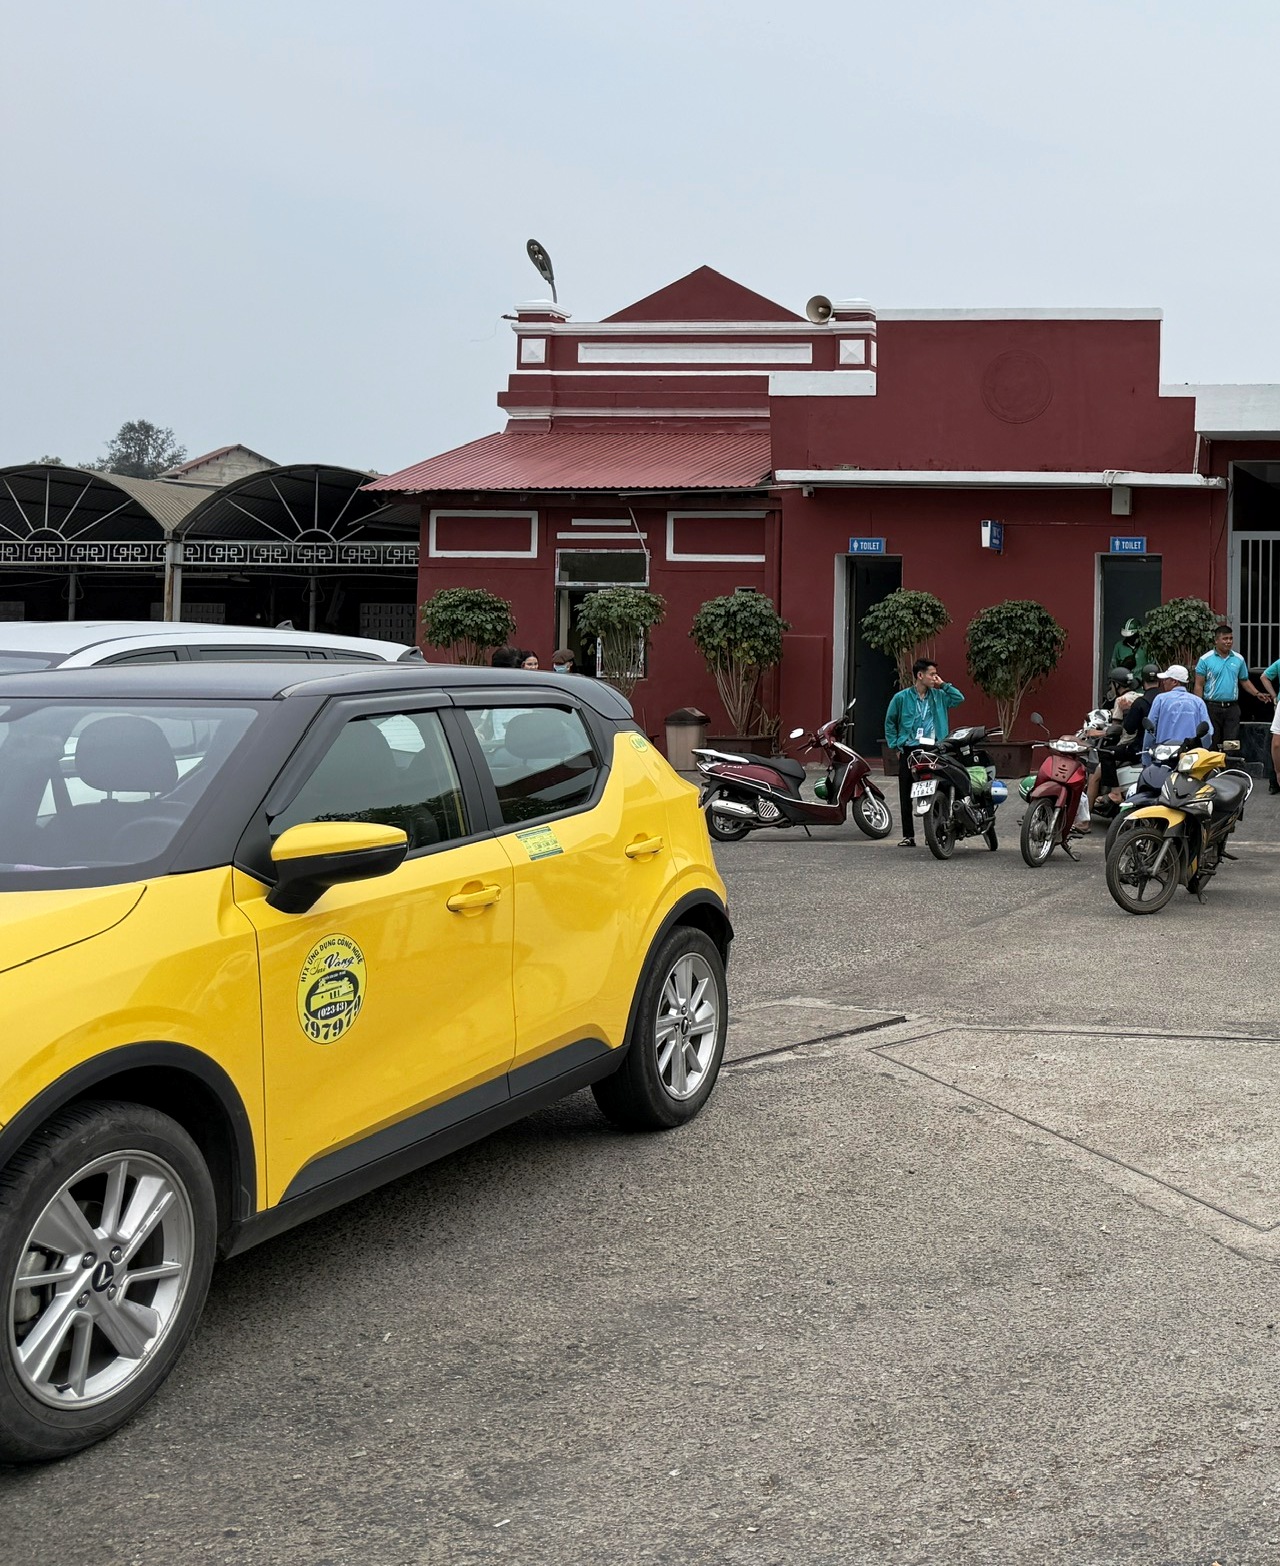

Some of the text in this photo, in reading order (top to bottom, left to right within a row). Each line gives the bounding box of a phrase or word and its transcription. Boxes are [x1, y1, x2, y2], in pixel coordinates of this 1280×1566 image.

[860, 542, 880, 550] TOILET
[1122, 541, 1141, 550] TOILET
[324, 951, 355, 969] Vàng
[300, 966, 310, 982] HTX
[303, 994, 361, 1041] 797979
